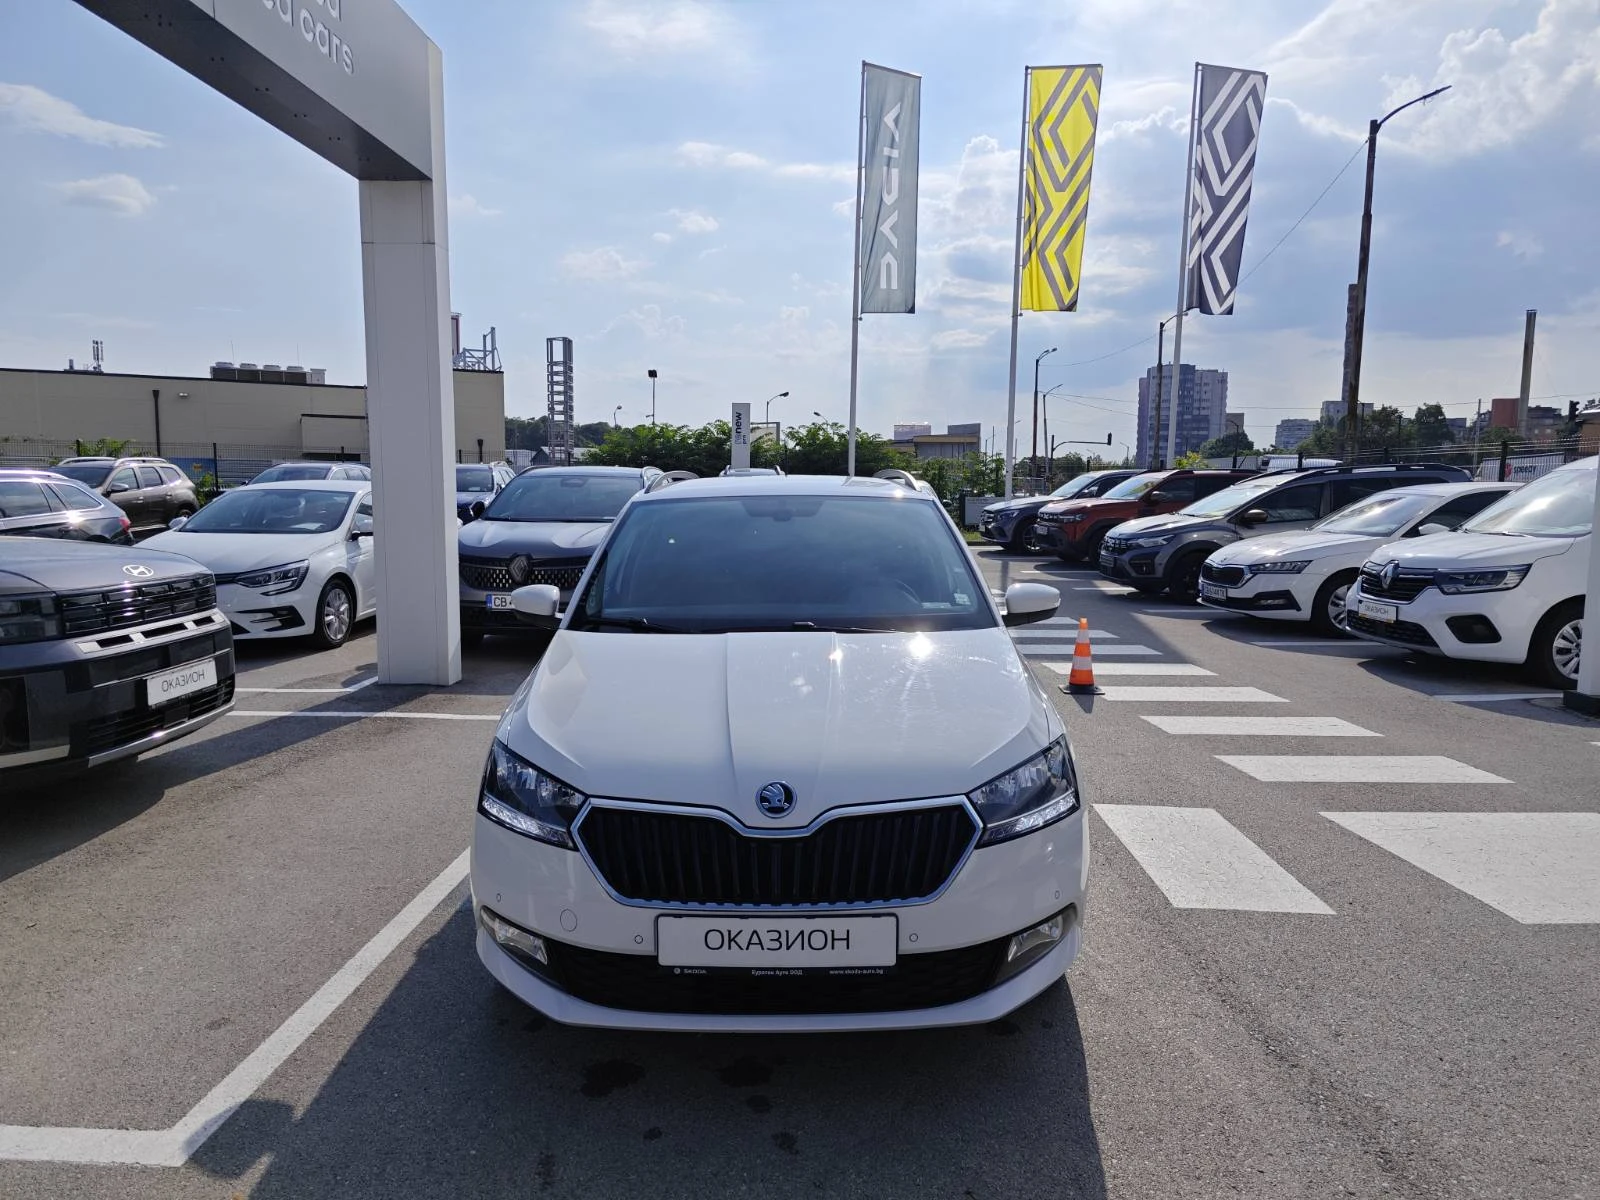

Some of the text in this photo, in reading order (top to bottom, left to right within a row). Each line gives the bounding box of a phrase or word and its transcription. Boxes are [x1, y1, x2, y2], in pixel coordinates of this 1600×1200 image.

[300, 8, 354, 75] cars
[880, 102, 901, 290] DACIA
[161, 669, 205, 692] ОКАЗИОН
[704, 929, 850, 951] ОКАЗИОН
